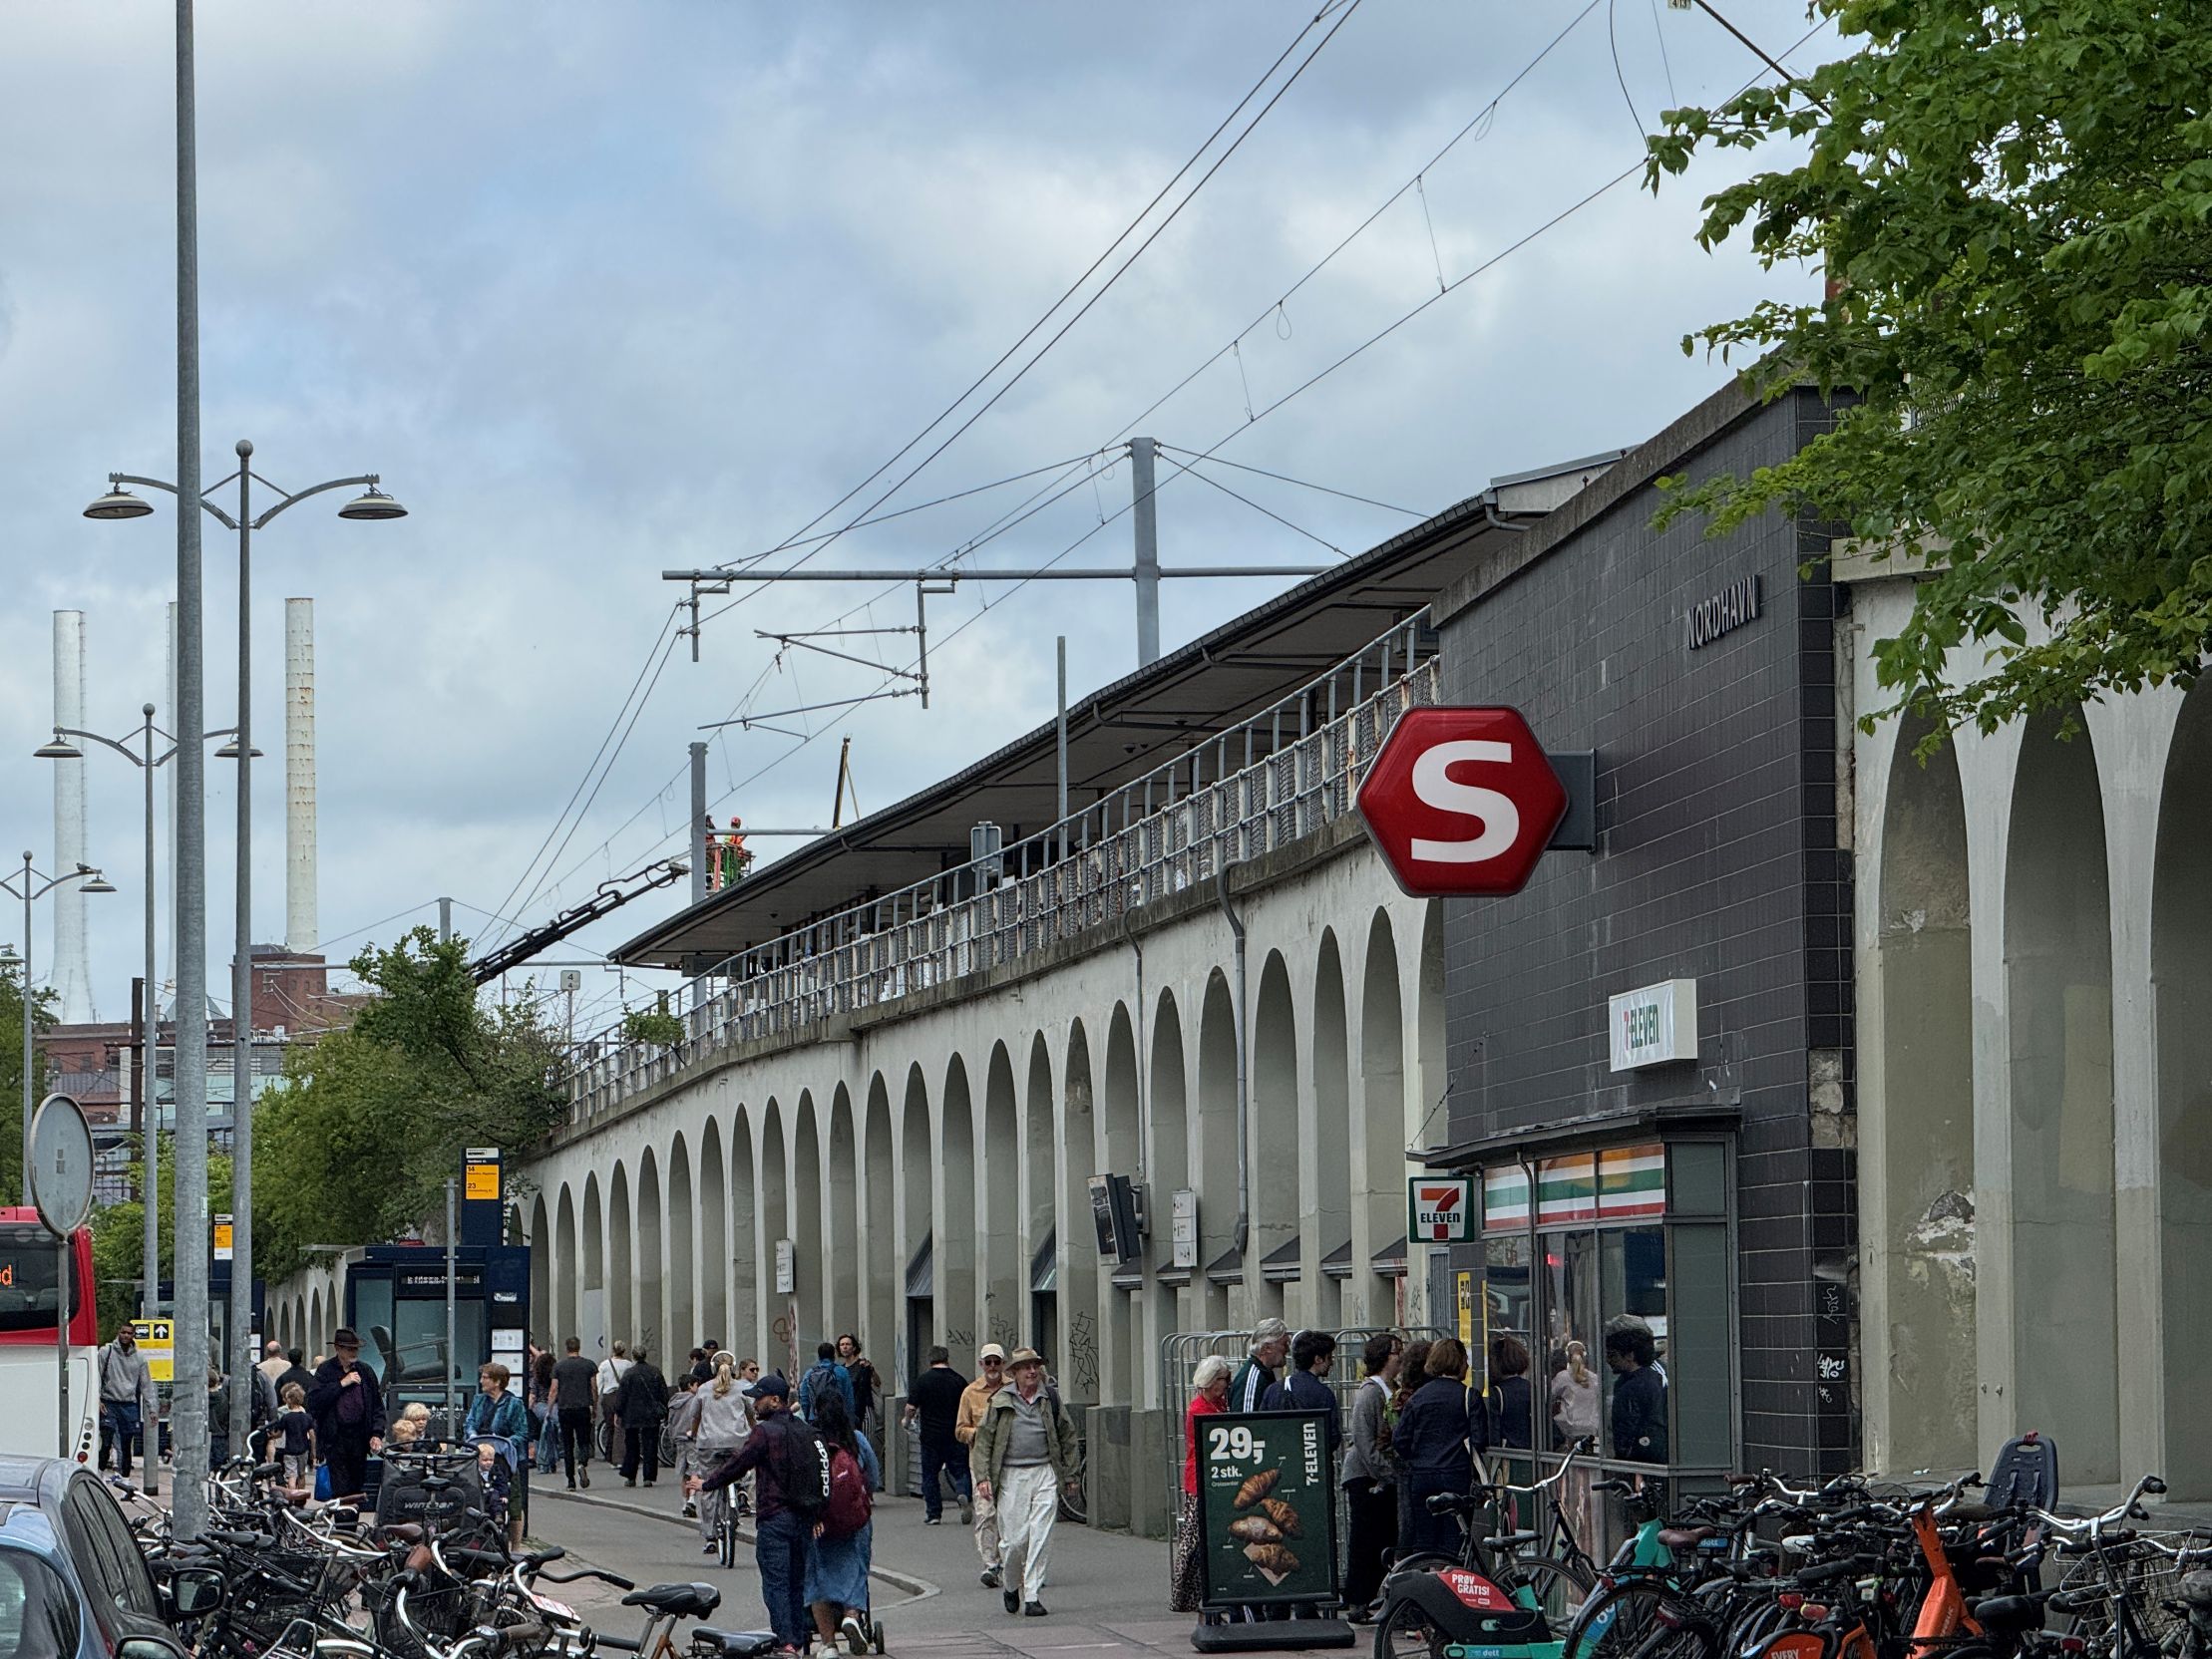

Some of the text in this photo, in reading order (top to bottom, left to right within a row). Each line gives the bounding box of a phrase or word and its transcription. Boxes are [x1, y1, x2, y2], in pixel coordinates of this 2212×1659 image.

[1686, 574, 1757, 650] NORDHAVN
[1411, 740, 1520, 863] S
[814, 1440, 830, 1497] adidas
[1211, 1466, 1243, 1479] 2 stk.
[1700, 1537, 1718, 1546] dott
[1451, 1573, 1475, 1585] PRØV
[1457, 1583, 1490, 1596] GRATIS!
[1482, 1648, 1500, 1657] dott
